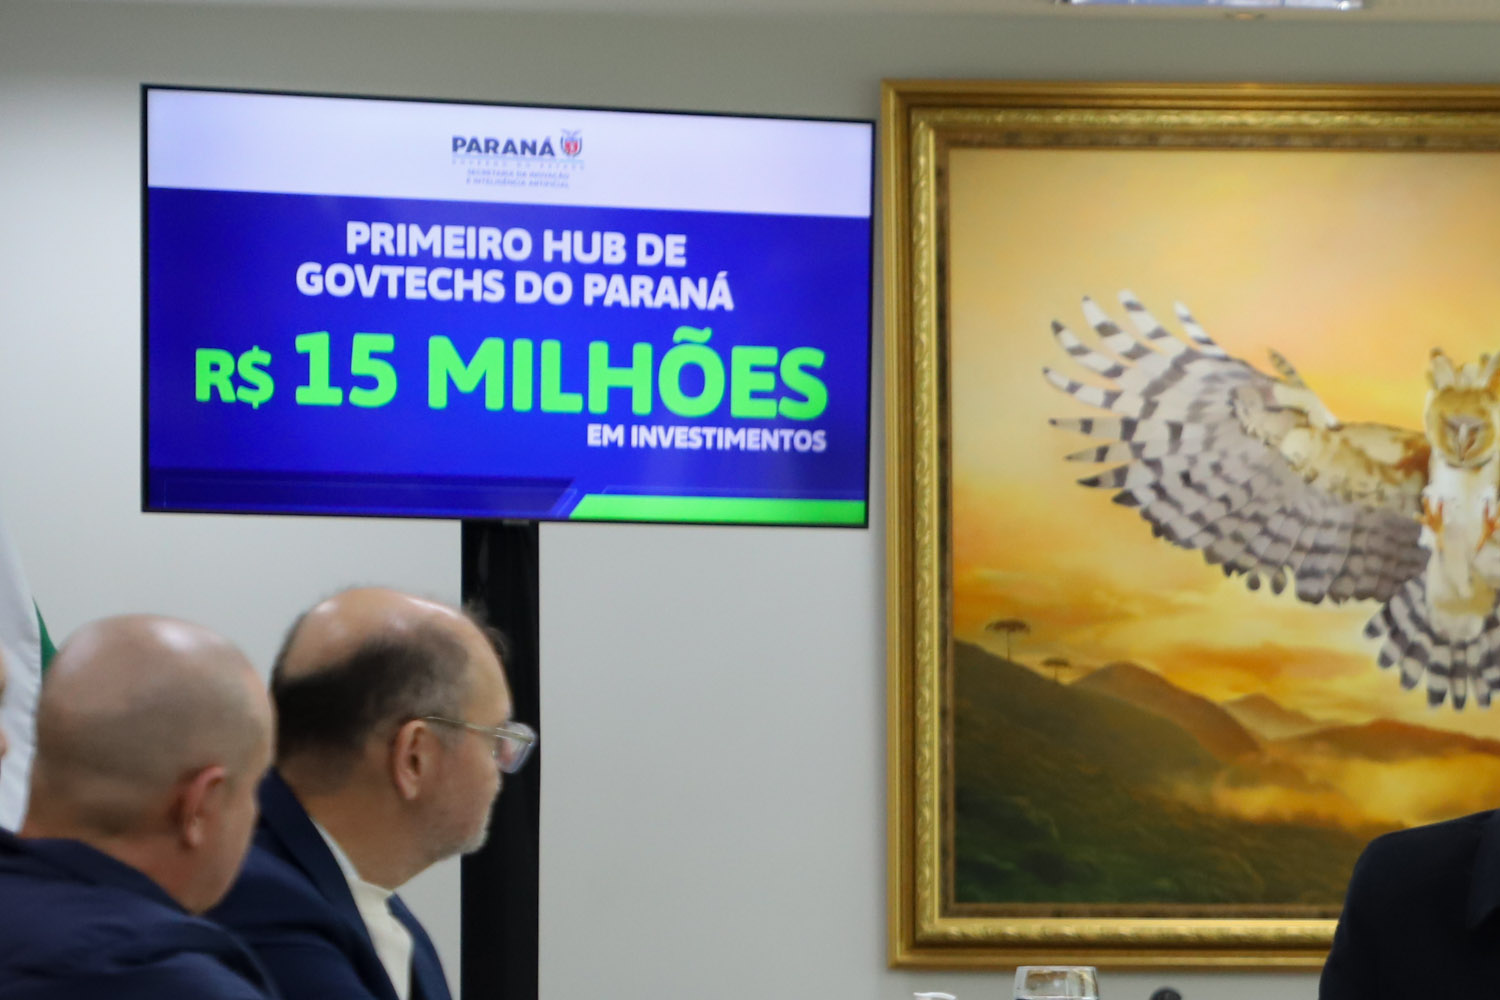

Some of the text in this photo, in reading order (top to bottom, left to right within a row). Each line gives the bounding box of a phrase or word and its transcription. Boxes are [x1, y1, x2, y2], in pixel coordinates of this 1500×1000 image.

[452, 134, 555, 157] PARANÁ
[345, 220, 687, 267] PRIMEIRO HUB DE
[296, 261, 735, 312] GOVTECHS DO PARANÁ
[194, 324, 829, 421] R$ 15 MILHÕES
[586, 422, 828, 454] EM INVESTIMENTOS
